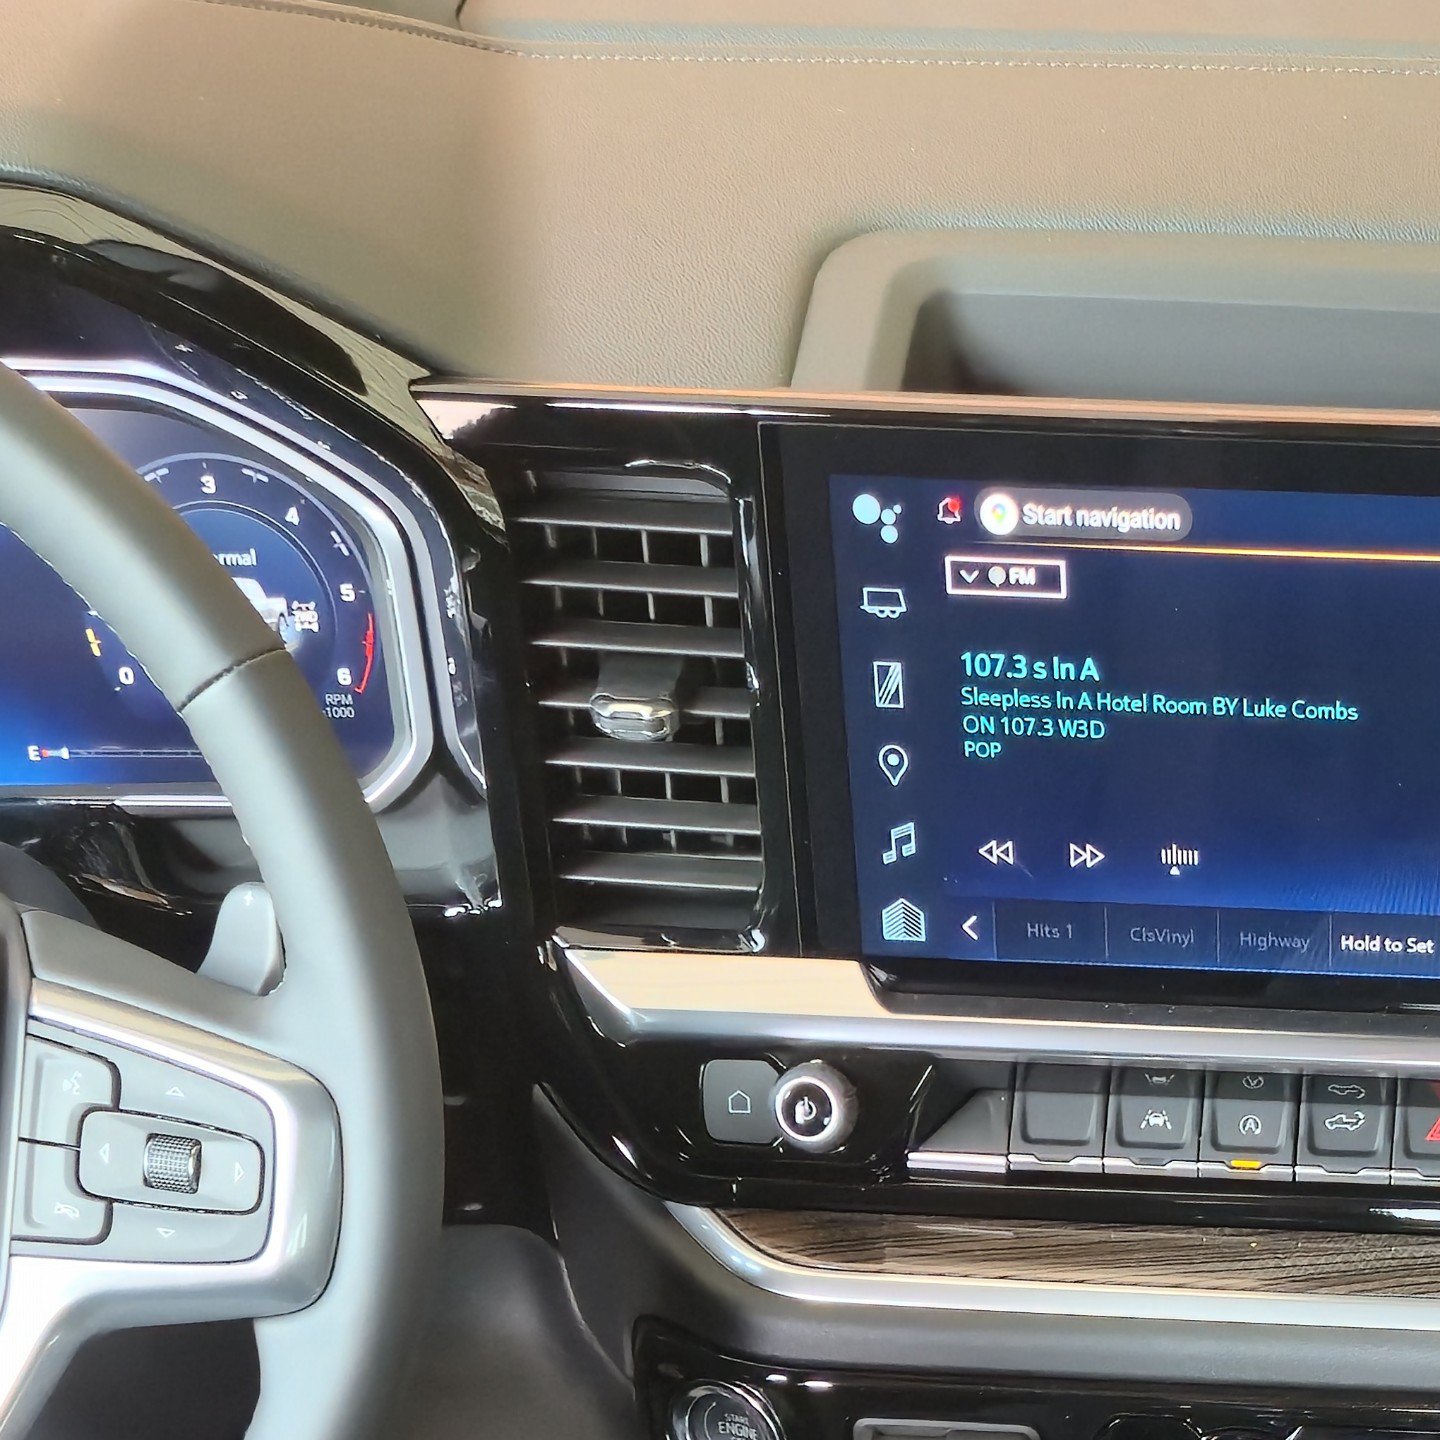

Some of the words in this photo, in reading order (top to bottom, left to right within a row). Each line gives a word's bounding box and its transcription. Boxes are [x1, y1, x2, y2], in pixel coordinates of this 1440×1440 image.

[200, 475, 216, 494] 3
[285, 506, 300, 526] 4
[1023, 503, 1072, 527] Start
[1077, 506, 1181, 533] navigation
[215, 548, 257, 566] rmal
[1009, 567, 1036, 586] FM
[340, 583, 356, 602] 5
[118, 667, 135, 685] 0
[337, 667, 352, 686] 6
[960, 652, 1027, 679] 107.3
[1033, 662, 1047, 681] s
[1053, 656, 1076, 681] In
[1079, 657, 1100, 682] A
[325, 693, 353, 705] RPM
[961, 687, 1051, 712] Sleepless
[1057, 689, 1074, 709] In
[1077, 690, 1093, 710] A
[1098, 691, 1148, 713] Hotel
[1154, 695, 1207, 716] Room
[1213, 697, 1239, 716] BY
[1243, 699, 1287, 719] Luke
[1292, 699, 1359, 722] Combs
[962, 716, 995, 735] ON
[1001, 717, 1053, 738] 107.3
[1059, 720, 1106, 740] W3D
[28, 745, 42, 761] E
[964, 740, 1002, 759] POP
[1027, 923, 1061, 939] Hits
[1066, 924, 1073, 939] 1
[1130, 926, 1195, 946] ClsVinyl
[1240, 932, 1311, 952] Highway
[1340, 935, 1380, 954] Hold
[1384, 937, 1402, 953] to
[1405, 938, 1435, 955] Set
